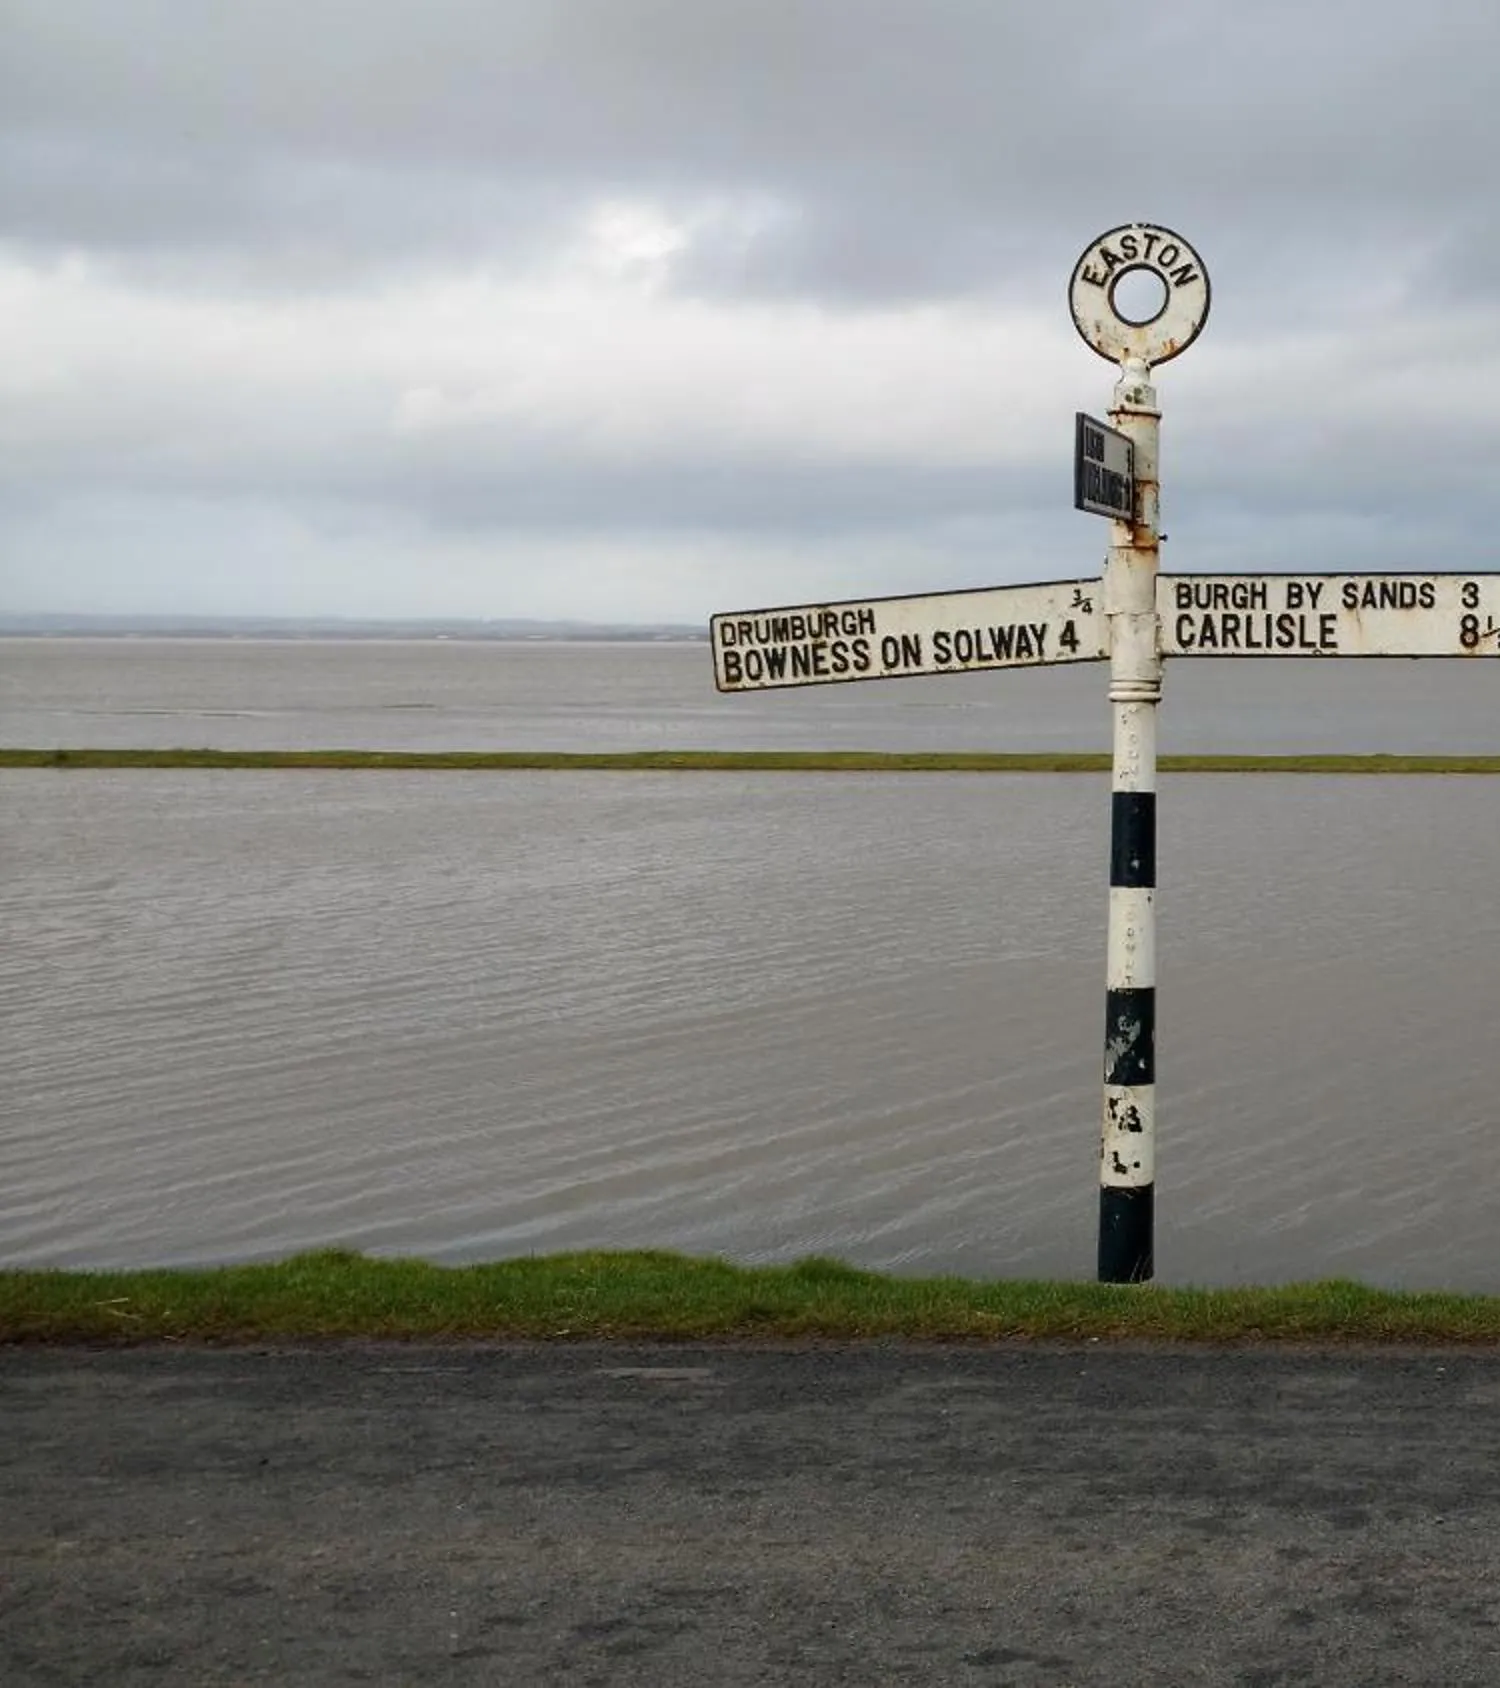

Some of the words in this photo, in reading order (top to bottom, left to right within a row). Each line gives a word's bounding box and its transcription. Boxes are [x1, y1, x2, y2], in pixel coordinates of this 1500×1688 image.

[1081, 232, 1199, 289] EASTON
[1175, 582, 1267, 610] BURGH
[1286, 582, 1325, 610] BY
[1342, 583, 1436, 610] SANDS
[1461, 582, 1480, 609] 3
[721, 608, 876, 647] DRUMBURGH
[1175, 613, 1339, 649] CARLISLE
[723, 640, 870, 684] BOWNESS
[881, 634, 922, 669] ON
[933, 622, 1048, 665] SOLWAY
[1059, 619, 1080, 654] 4
